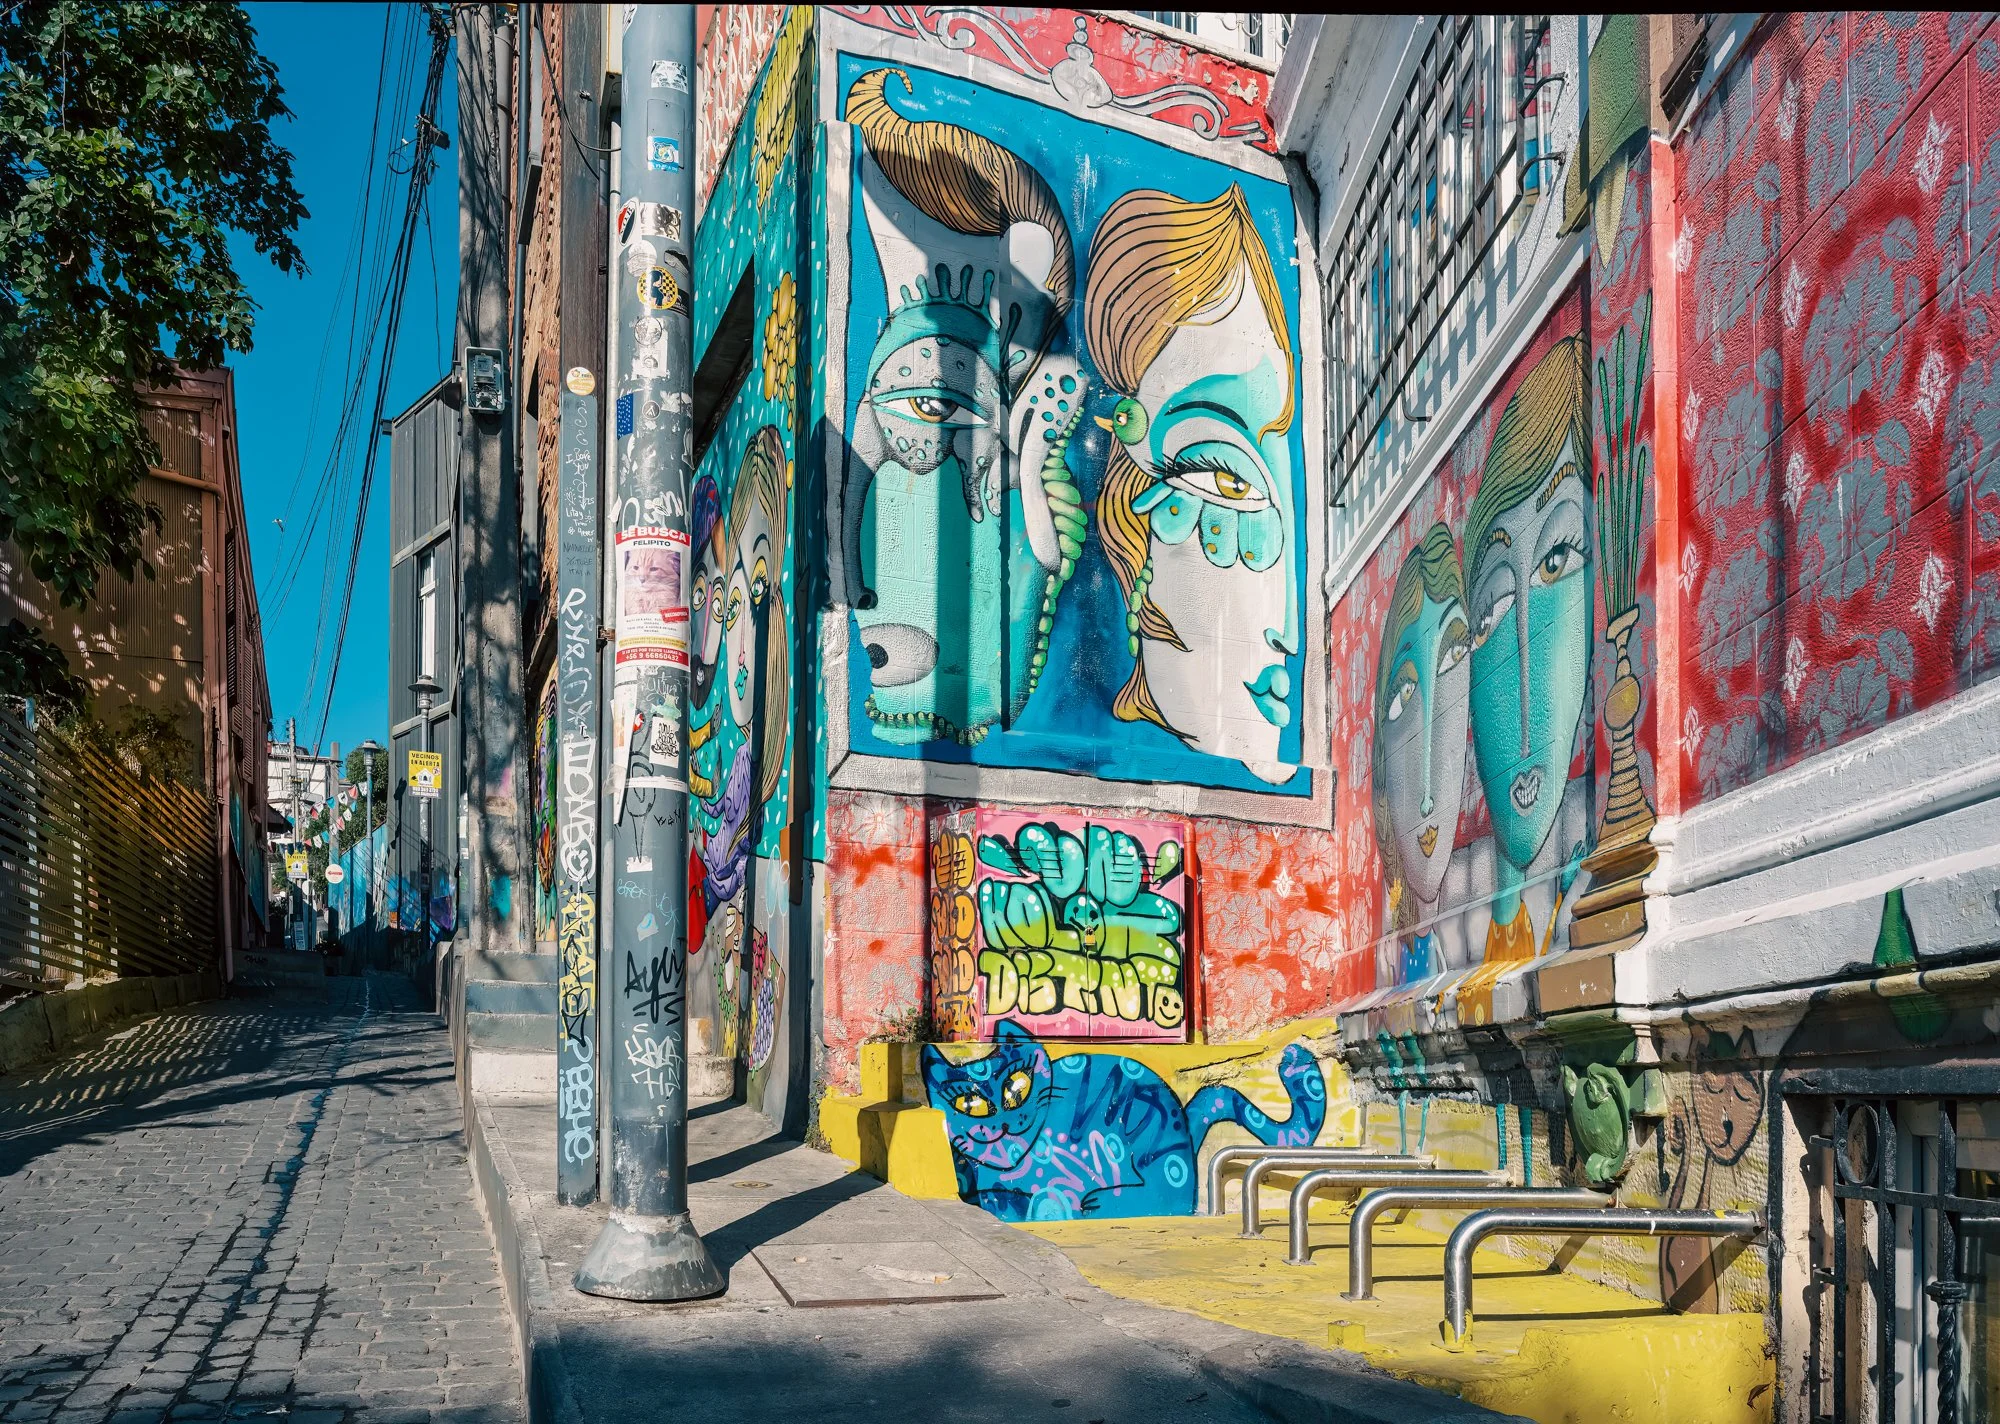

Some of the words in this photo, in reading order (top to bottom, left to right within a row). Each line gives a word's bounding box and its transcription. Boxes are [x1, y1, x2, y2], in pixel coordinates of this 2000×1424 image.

[621, 526, 637, 540] SE
[637, 526, 687, 543] BUSCA
[645, 652, 679, 661] 66860432
[411, 752, 439, 760] VECINOS
